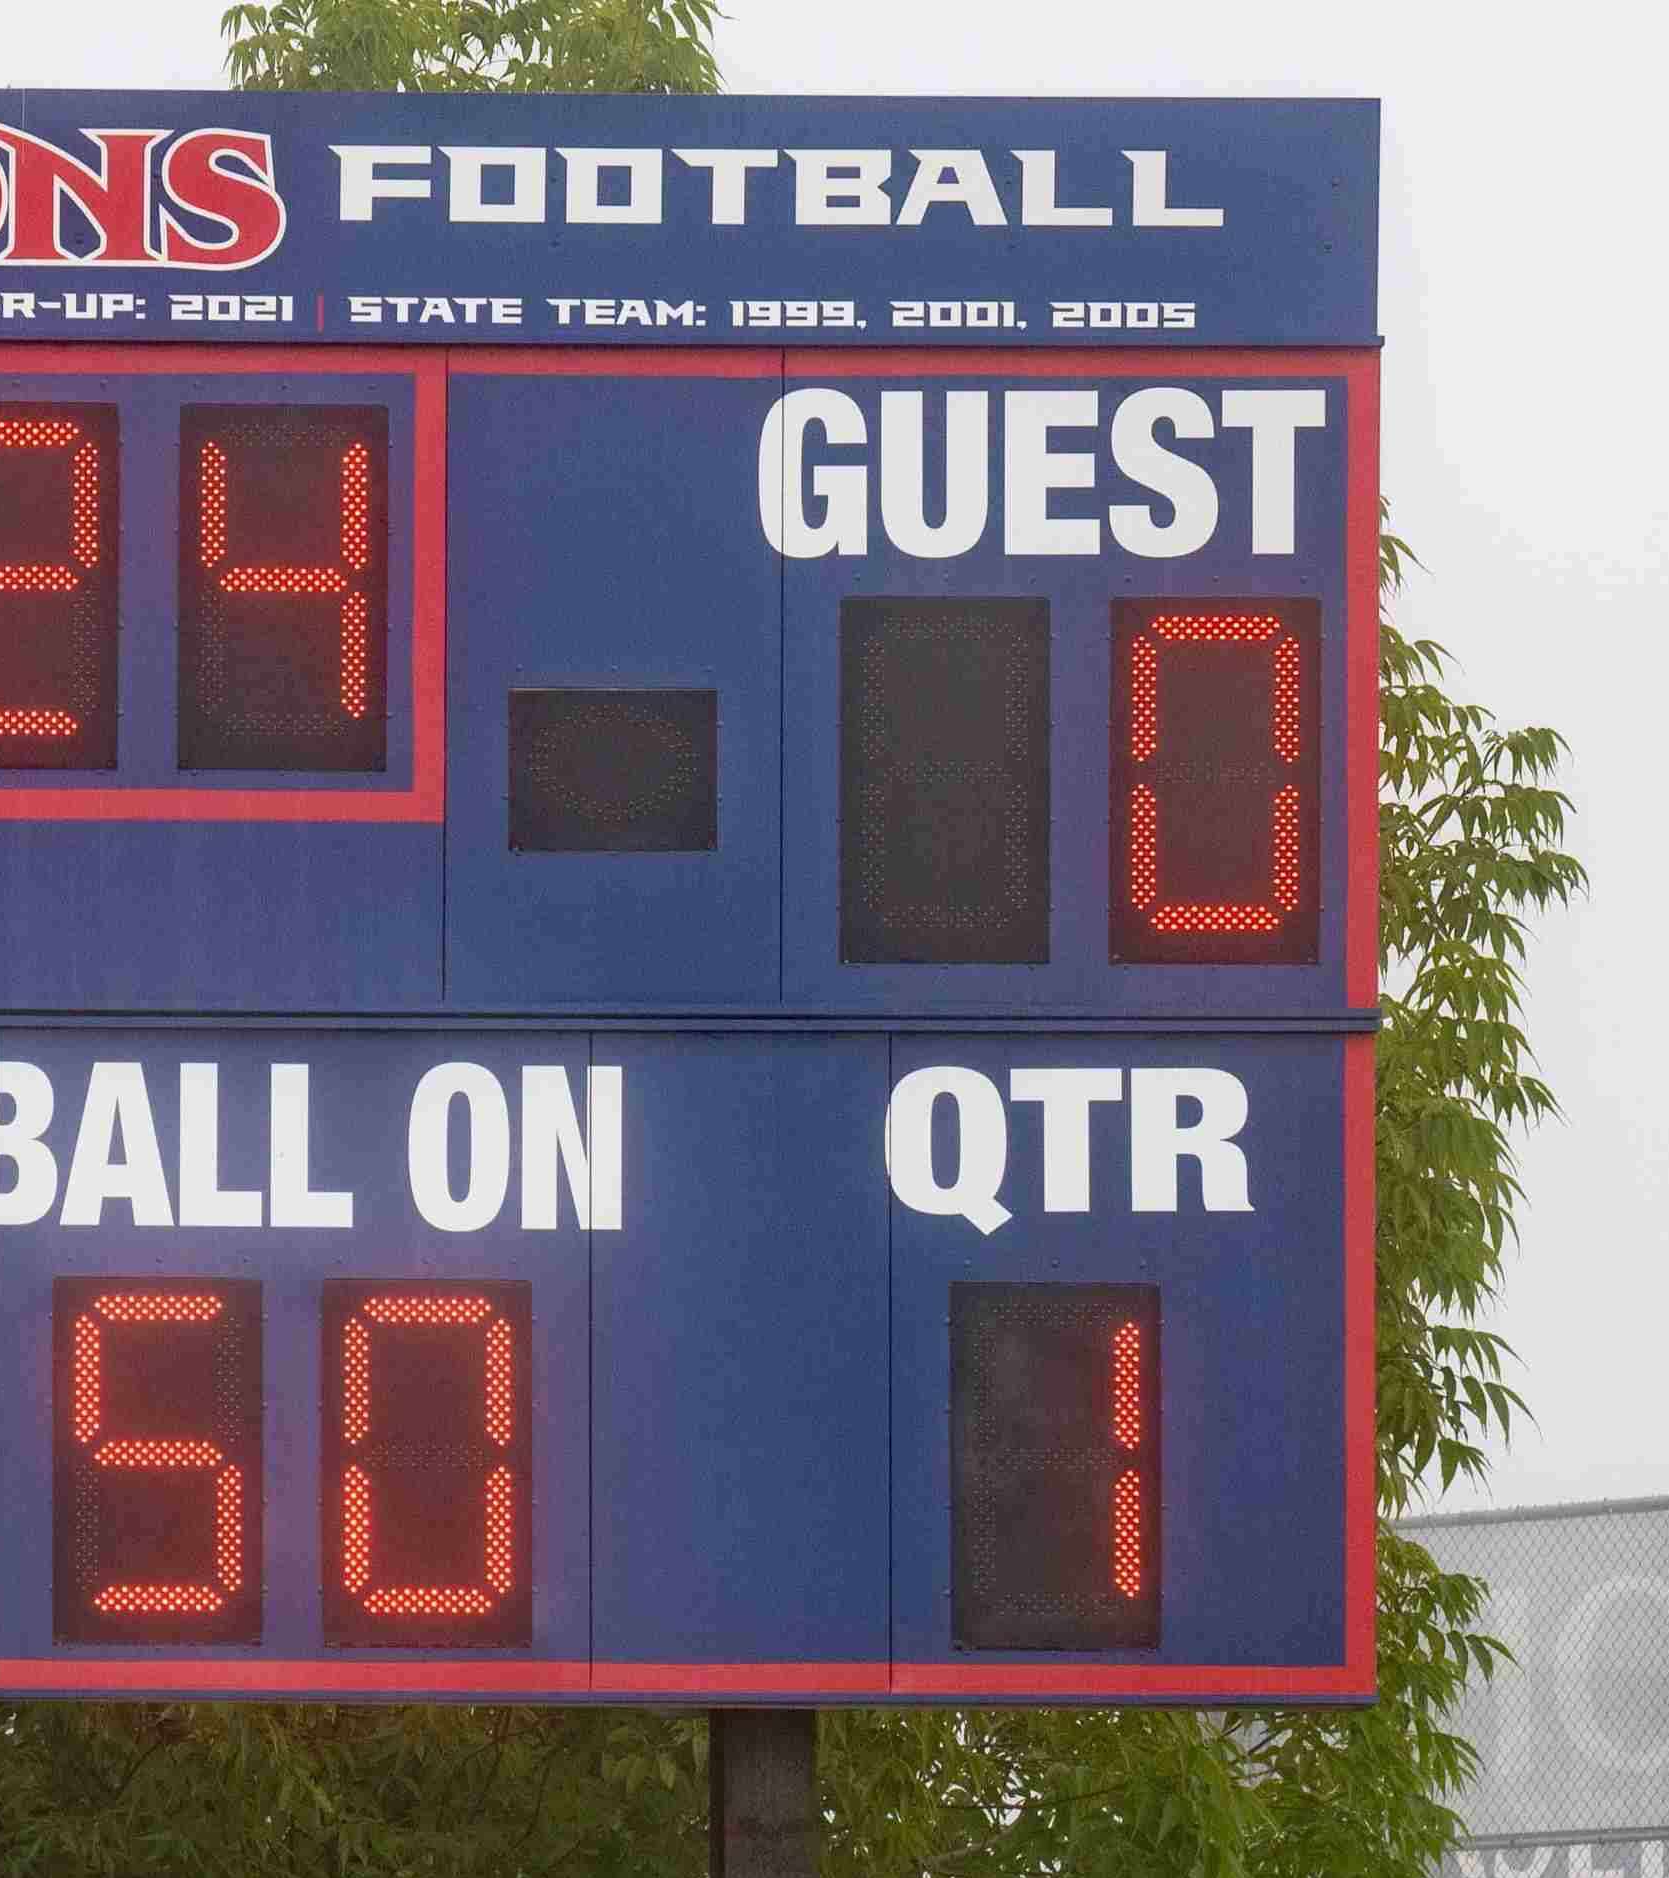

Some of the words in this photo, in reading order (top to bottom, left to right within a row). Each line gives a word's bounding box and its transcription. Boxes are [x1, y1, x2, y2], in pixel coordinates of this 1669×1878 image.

[328, 144, 1225, 228] FOOTBALL
[168, 293, 295, 323] 2021
[347, 294, 523, 326] STATE
[546, 296, 707, 328] TEAM:
[729, 298, 868, 331] 1999,
[888, 299, 1028, 331] 2001,
[1049, 300, 1197, 330] 2005
[756, 384, 1326, 560] GUEST
[1128, 613, 1302, 933] 0
[405, 1060, 624, 1231] ON
[886, 1064, 1256, 1237] QTR
[71, 1293, 516, 1618] 50
[1110, 1316, 1144, 1600] 1
